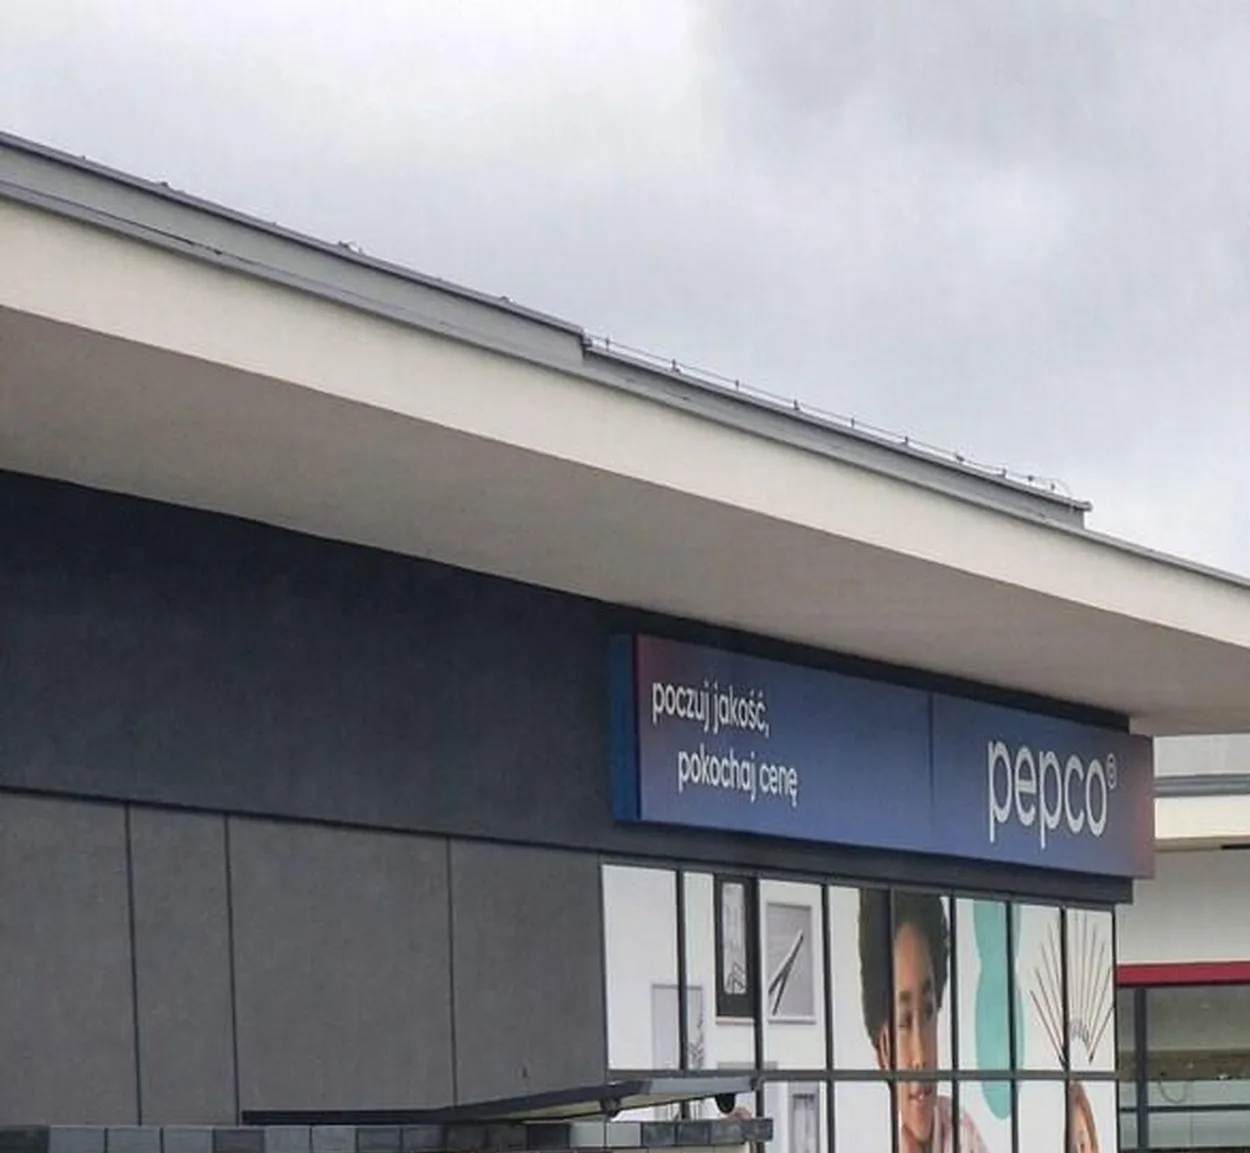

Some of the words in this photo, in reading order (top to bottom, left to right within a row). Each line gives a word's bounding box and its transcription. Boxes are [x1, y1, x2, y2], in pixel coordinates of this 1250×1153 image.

[652, 680, 710, 733] poczuj
[713, 681, 770, 738] jakość,
[678, 743, 757, 802] pokochaj
[759, 763, 798, 808] cenę
[988, 741, 1107, 849] pepco
